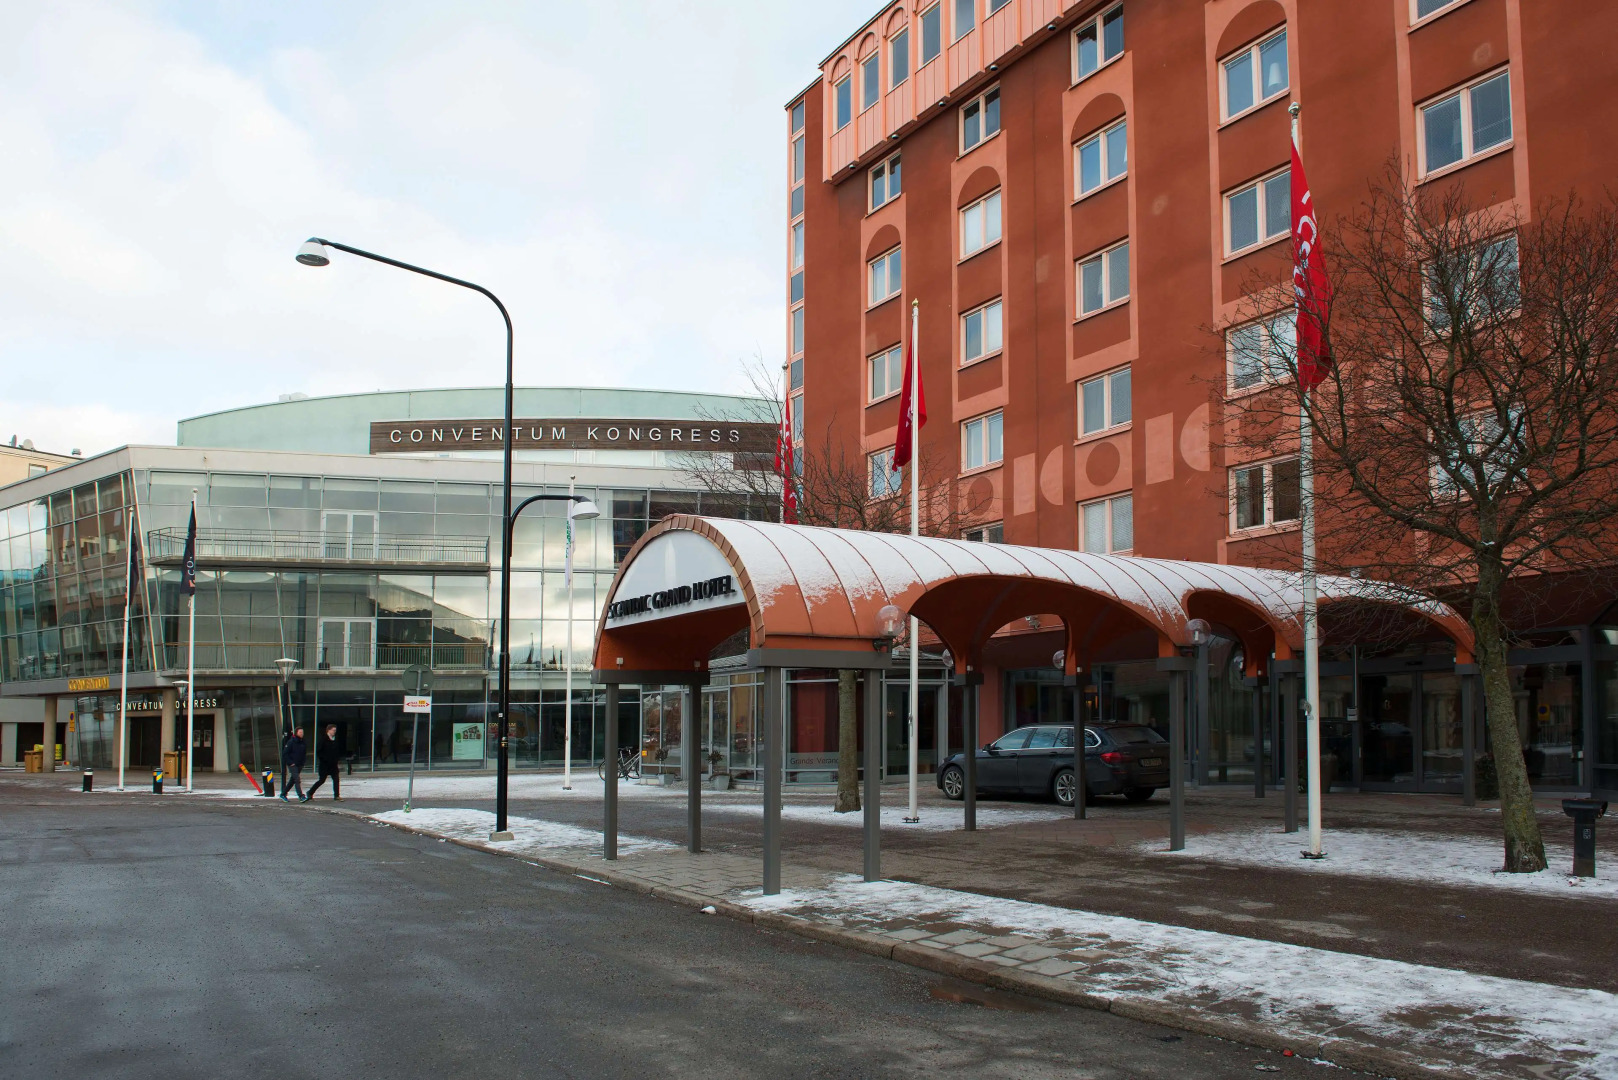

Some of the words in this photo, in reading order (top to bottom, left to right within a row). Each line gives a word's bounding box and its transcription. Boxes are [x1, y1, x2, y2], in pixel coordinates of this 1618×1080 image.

[390, 426, 566, 443] CONVENTUM
[587, 427, 740, 443] KONGRESS
[607, 594, 652, 619] SCANDIC
[651, 585, 692, 610] GRAND
[692, 575, 737, 601] HOTEL
[116, 700, 164, 711] CNVENTUM
[175, 698, 217, 709] ONRESS
